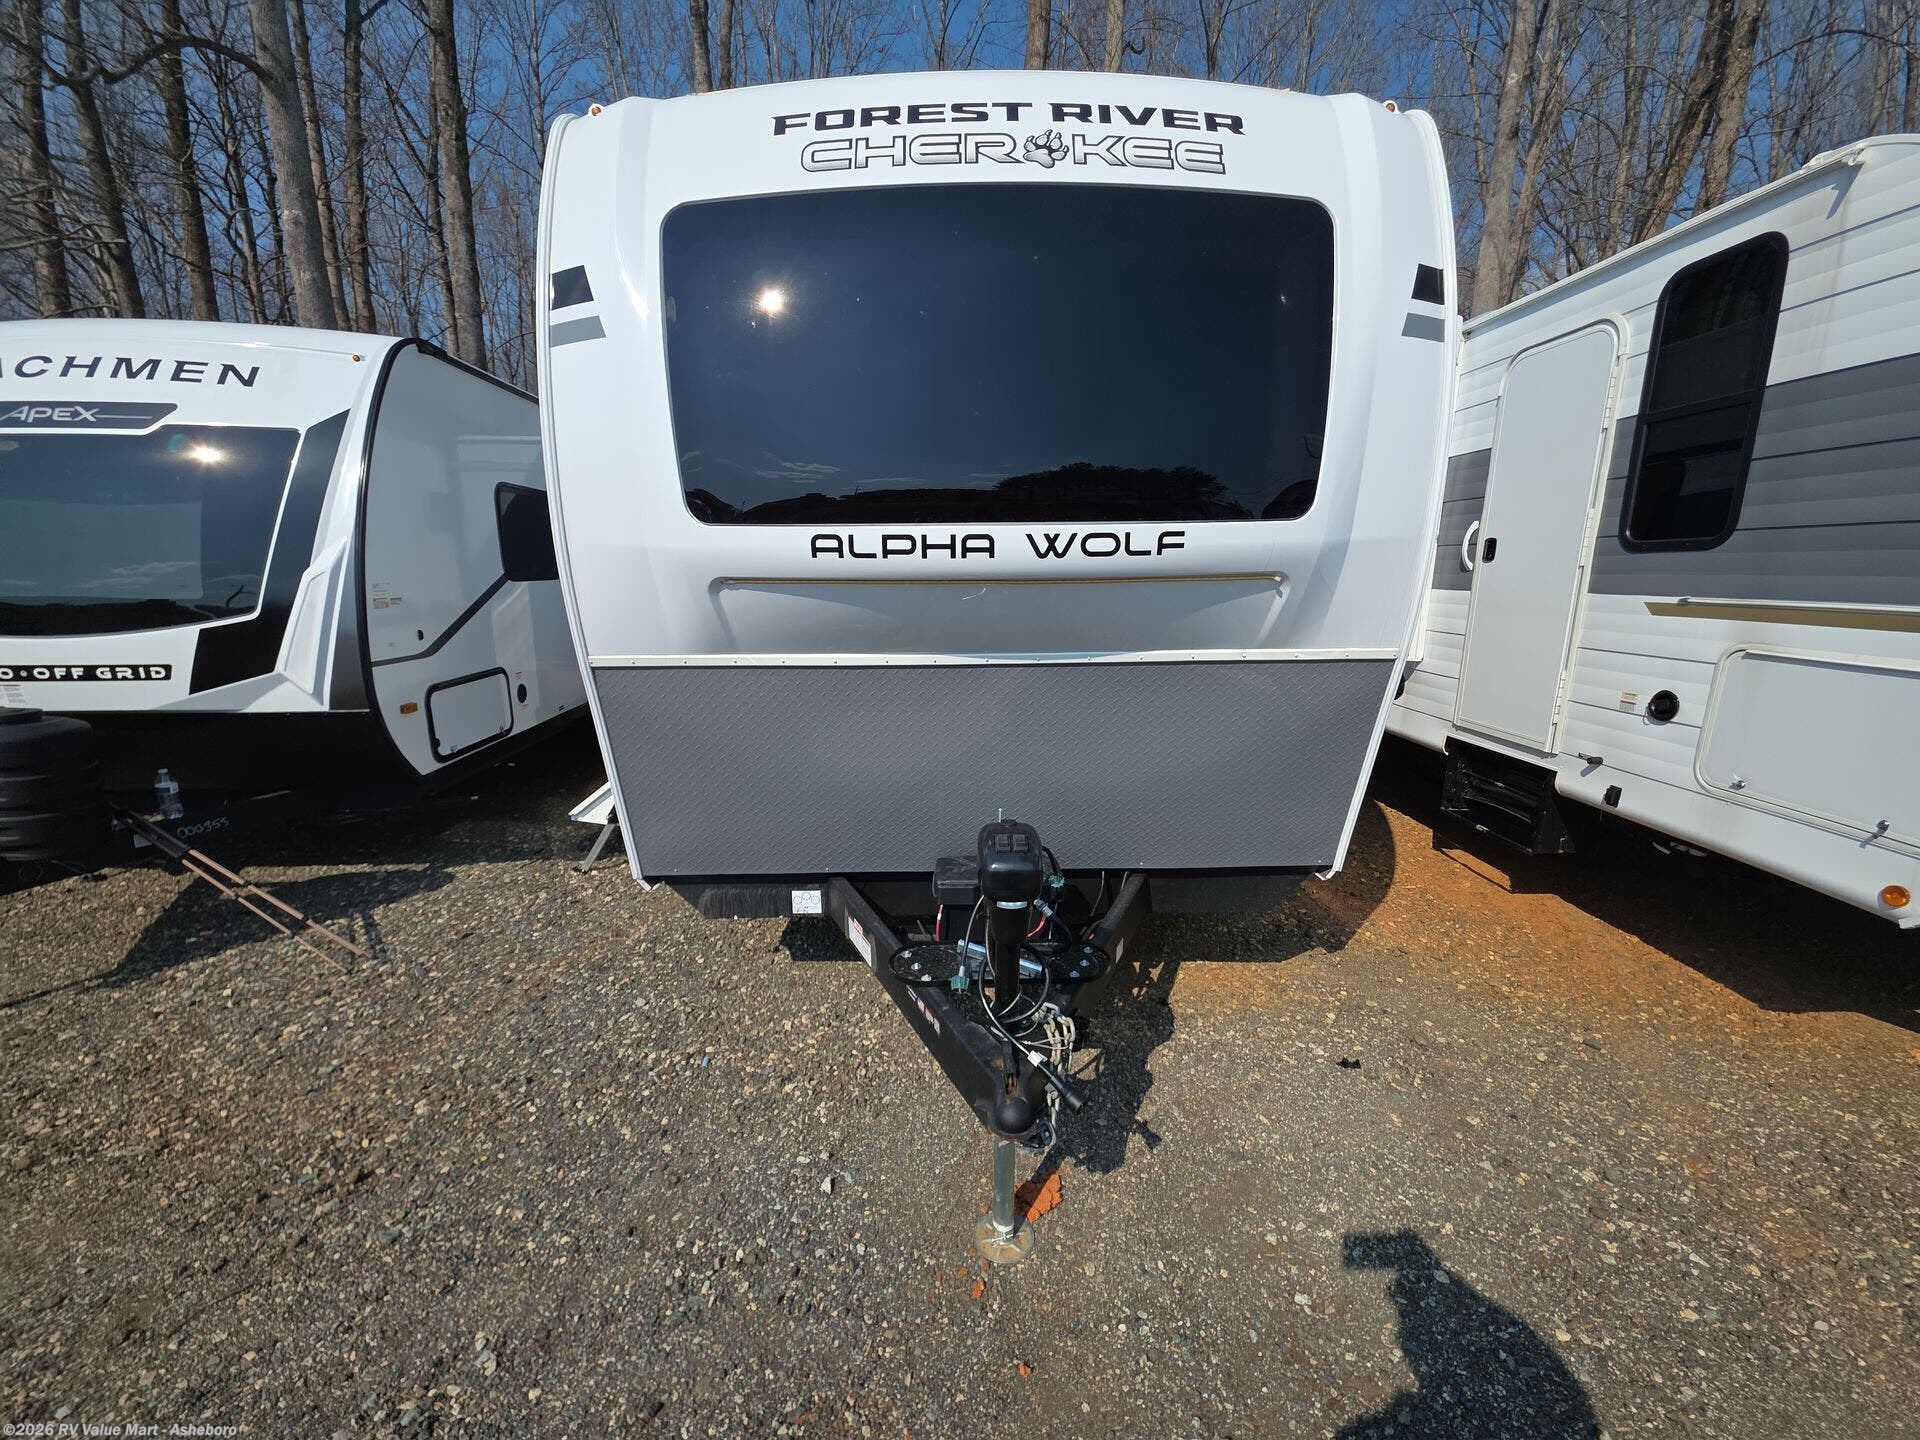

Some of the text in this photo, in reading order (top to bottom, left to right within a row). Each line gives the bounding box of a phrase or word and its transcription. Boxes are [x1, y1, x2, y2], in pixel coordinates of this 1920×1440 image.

[772, 102, 1245, 136] FOREST RIVER
[0, 355, 260, 387] CHMEN
[2, 405, 99, 423] APEX
[811, 530, 1186, 559] ALPHA WOLF
[96, 667, 166, 679] GRID
